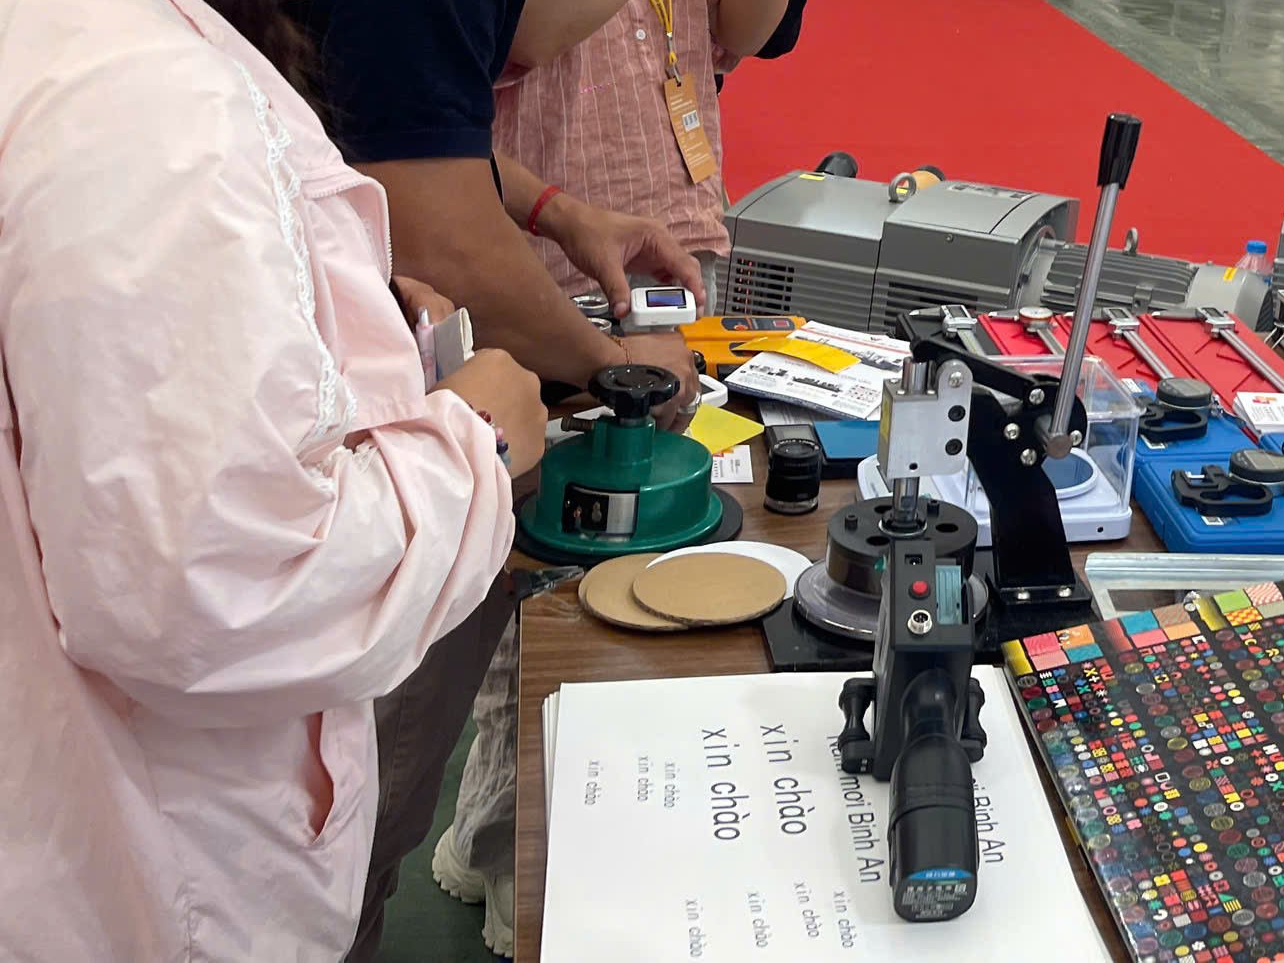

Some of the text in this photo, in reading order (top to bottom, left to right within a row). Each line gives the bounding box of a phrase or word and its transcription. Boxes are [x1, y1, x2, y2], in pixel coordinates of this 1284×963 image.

[587, 760, 604, 778] xin
[638, 756, 653, 774] xin
[664, 763, 680, 780] xin
[702, 728, 750, 840] xin chào
[759, 724, 815, 835] xin chào
[978, 838, 1006, 864] An
[857, 856, 885, 883] An
[748, 891, 765, 913] xin
[794, 881, 812, 904] xin
[833, 891, 851, 913] xin
[685, 899, 703, 921] xin
